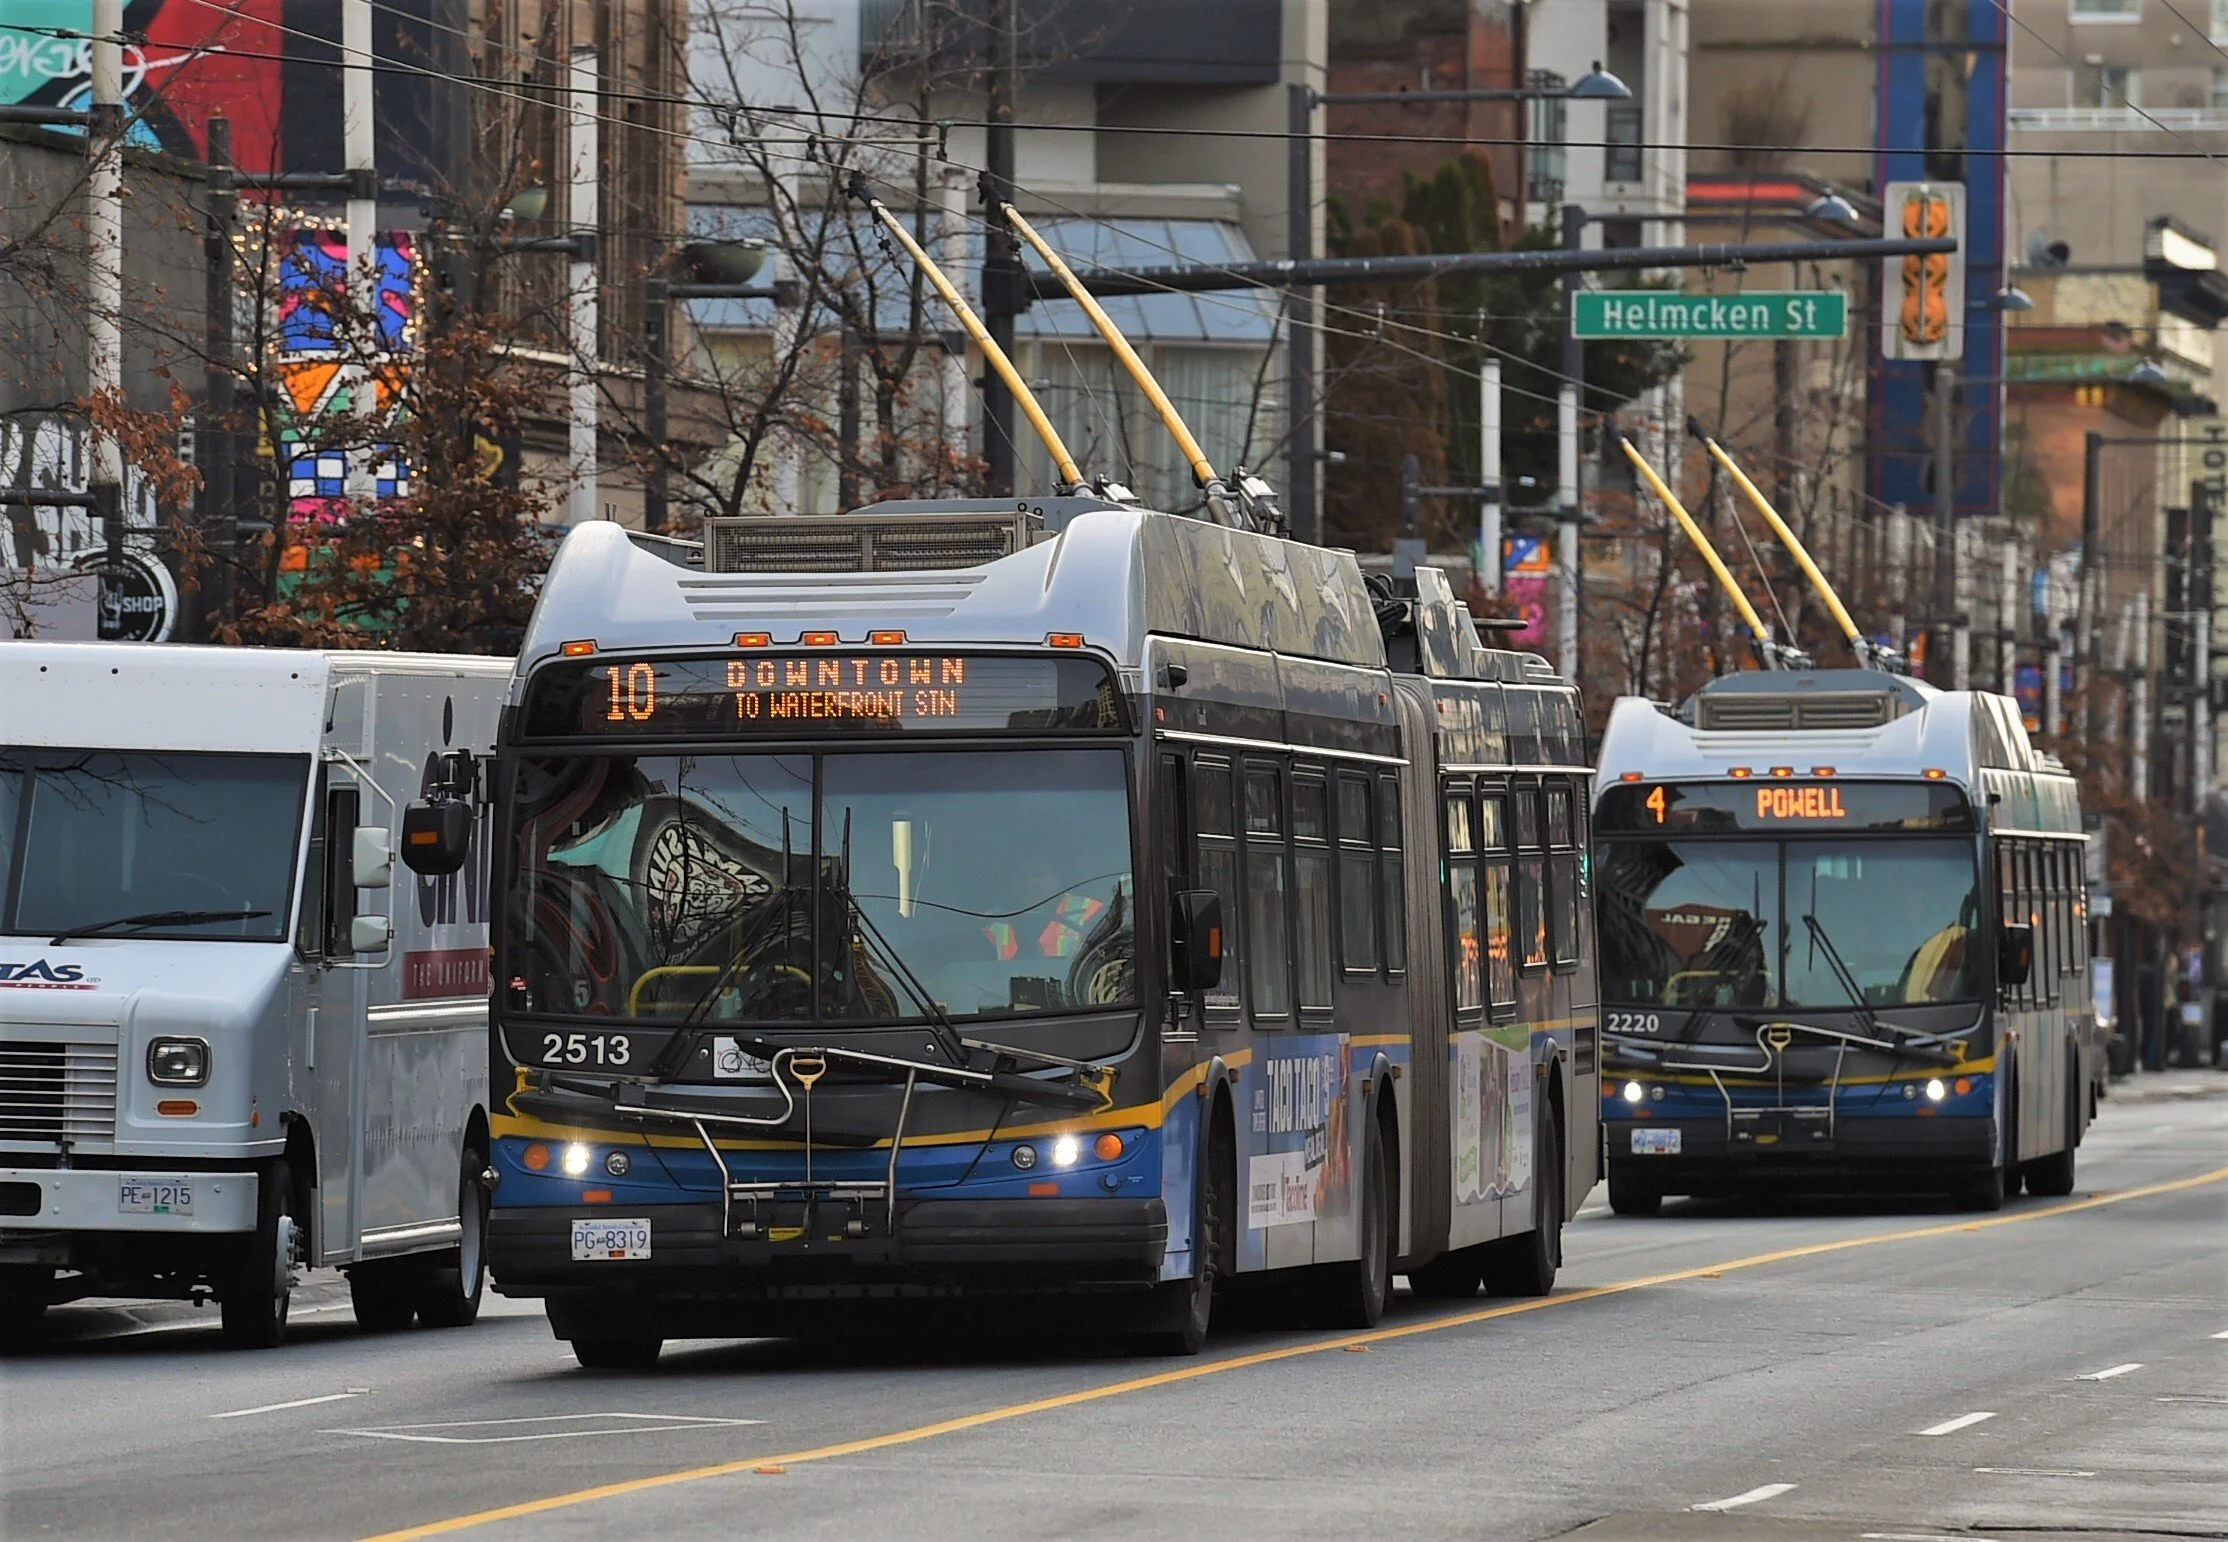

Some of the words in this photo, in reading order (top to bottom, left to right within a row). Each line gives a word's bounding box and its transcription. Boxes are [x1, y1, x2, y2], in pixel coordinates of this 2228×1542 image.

[1602, 299, 1769, 330] Helmcken
[1785, 299, 1816, 330] St
[122, 596, 163, 613] SHOP
[727, 657, 965, 687] DOWNTOWN
[606, 662, 655, 720] 10
[736, 692, 759, 719] TO
[770, 690, 904, 719] WATERFRONT
[914, 689, 956, 717] STN
[1646, 786, 1665, 823] 4
[1757, 787, 1846, 818] POWELL
[413, 963, 431, 986] THE
[438, 960, 484, 986] UNIFORM
[1608, 1013, 1659, 1033] 2220
[542, 1033, 630, 1065] 2513
[1267, 1058, 1292, 1133] TACO
[1295, 1056, 1319, 1130] TACO
